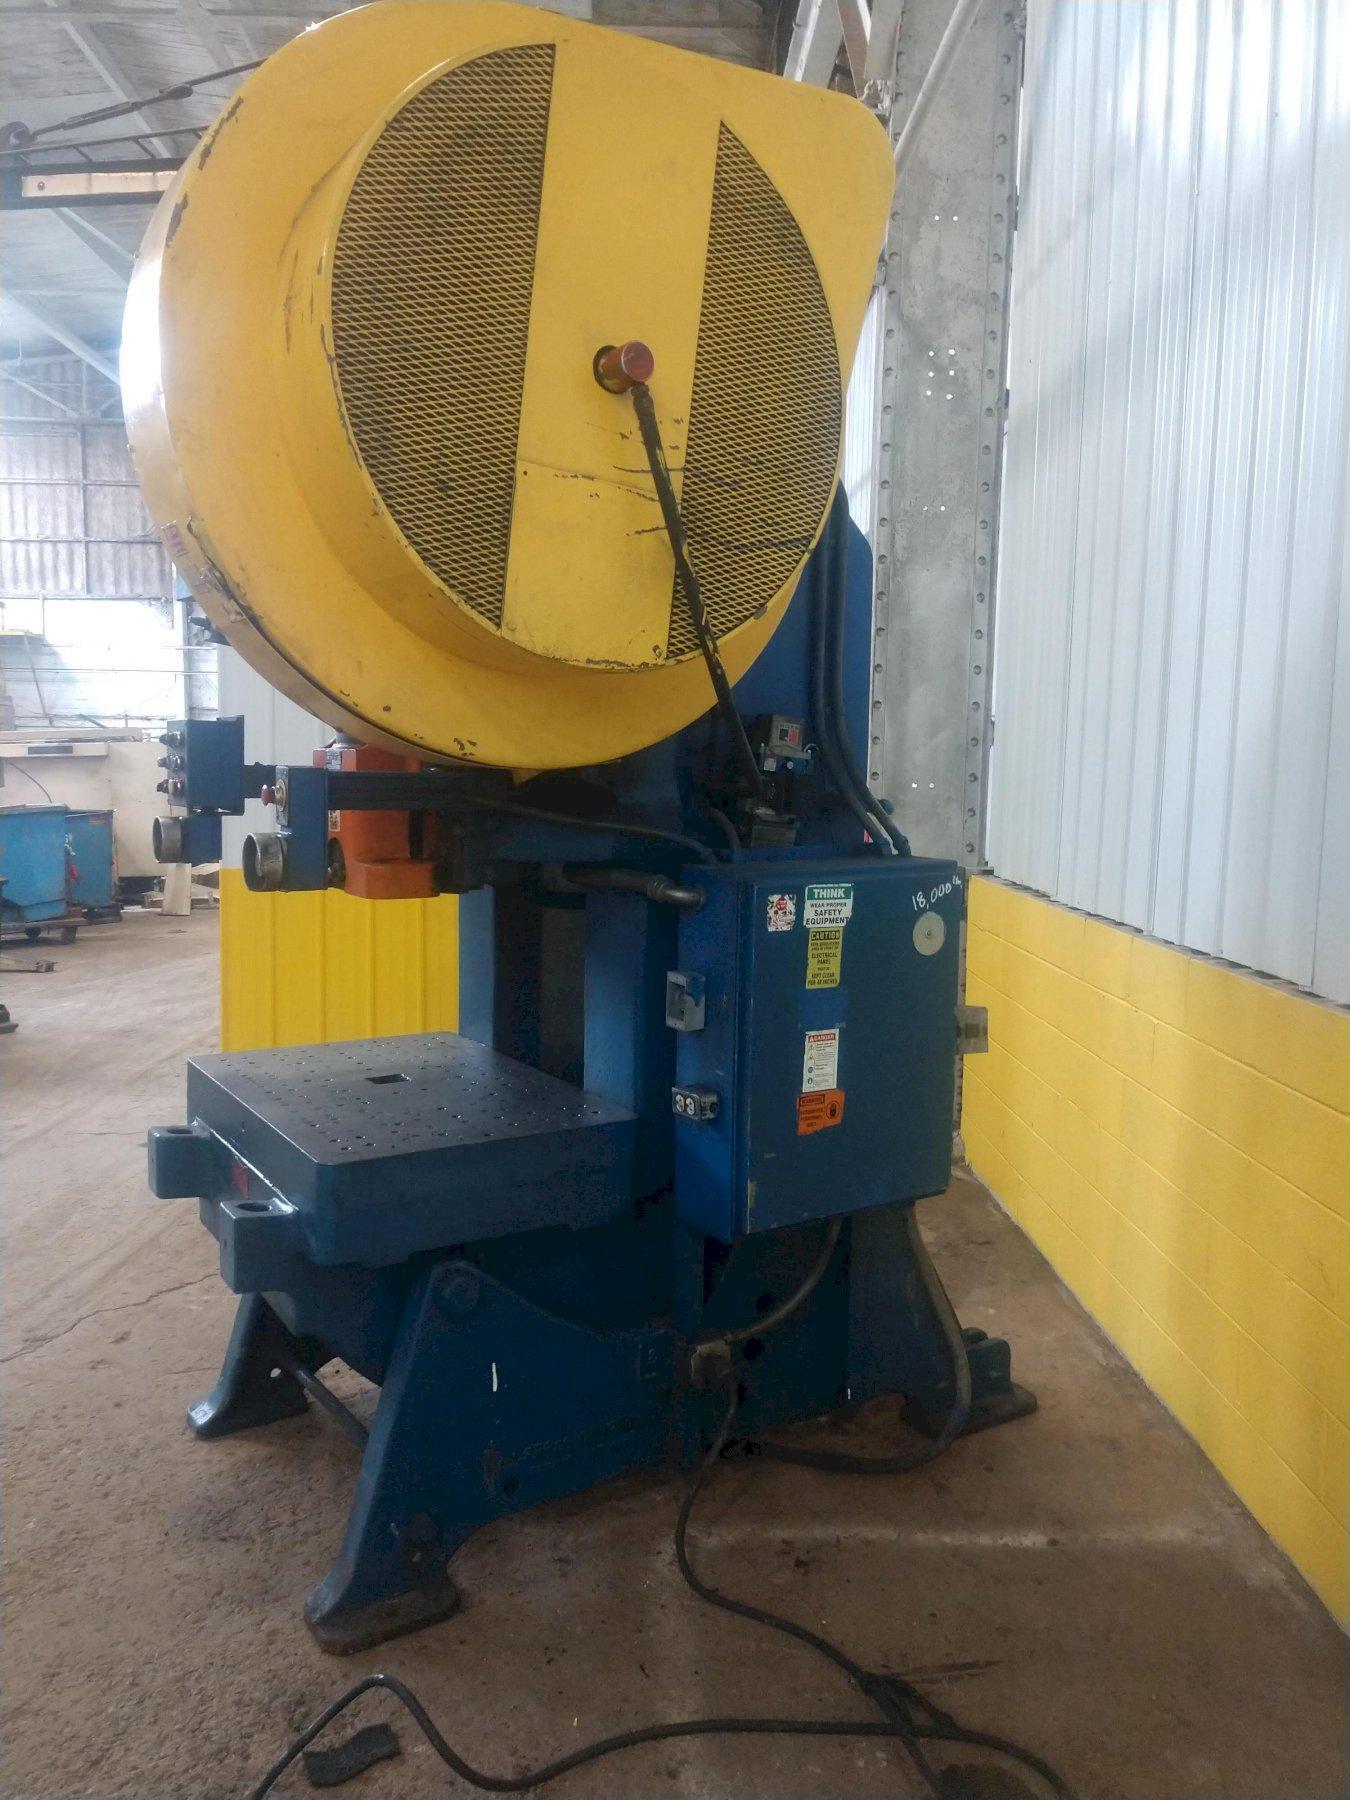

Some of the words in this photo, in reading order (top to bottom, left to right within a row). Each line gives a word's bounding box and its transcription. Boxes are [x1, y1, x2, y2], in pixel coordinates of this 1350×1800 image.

[812, 888, 846, 899] THINK
[814, 909, 843, 917] SAFETY
[806, 916, 850, 925] EQUIPMENT
[811, 931, 840, 940] CAUTION
